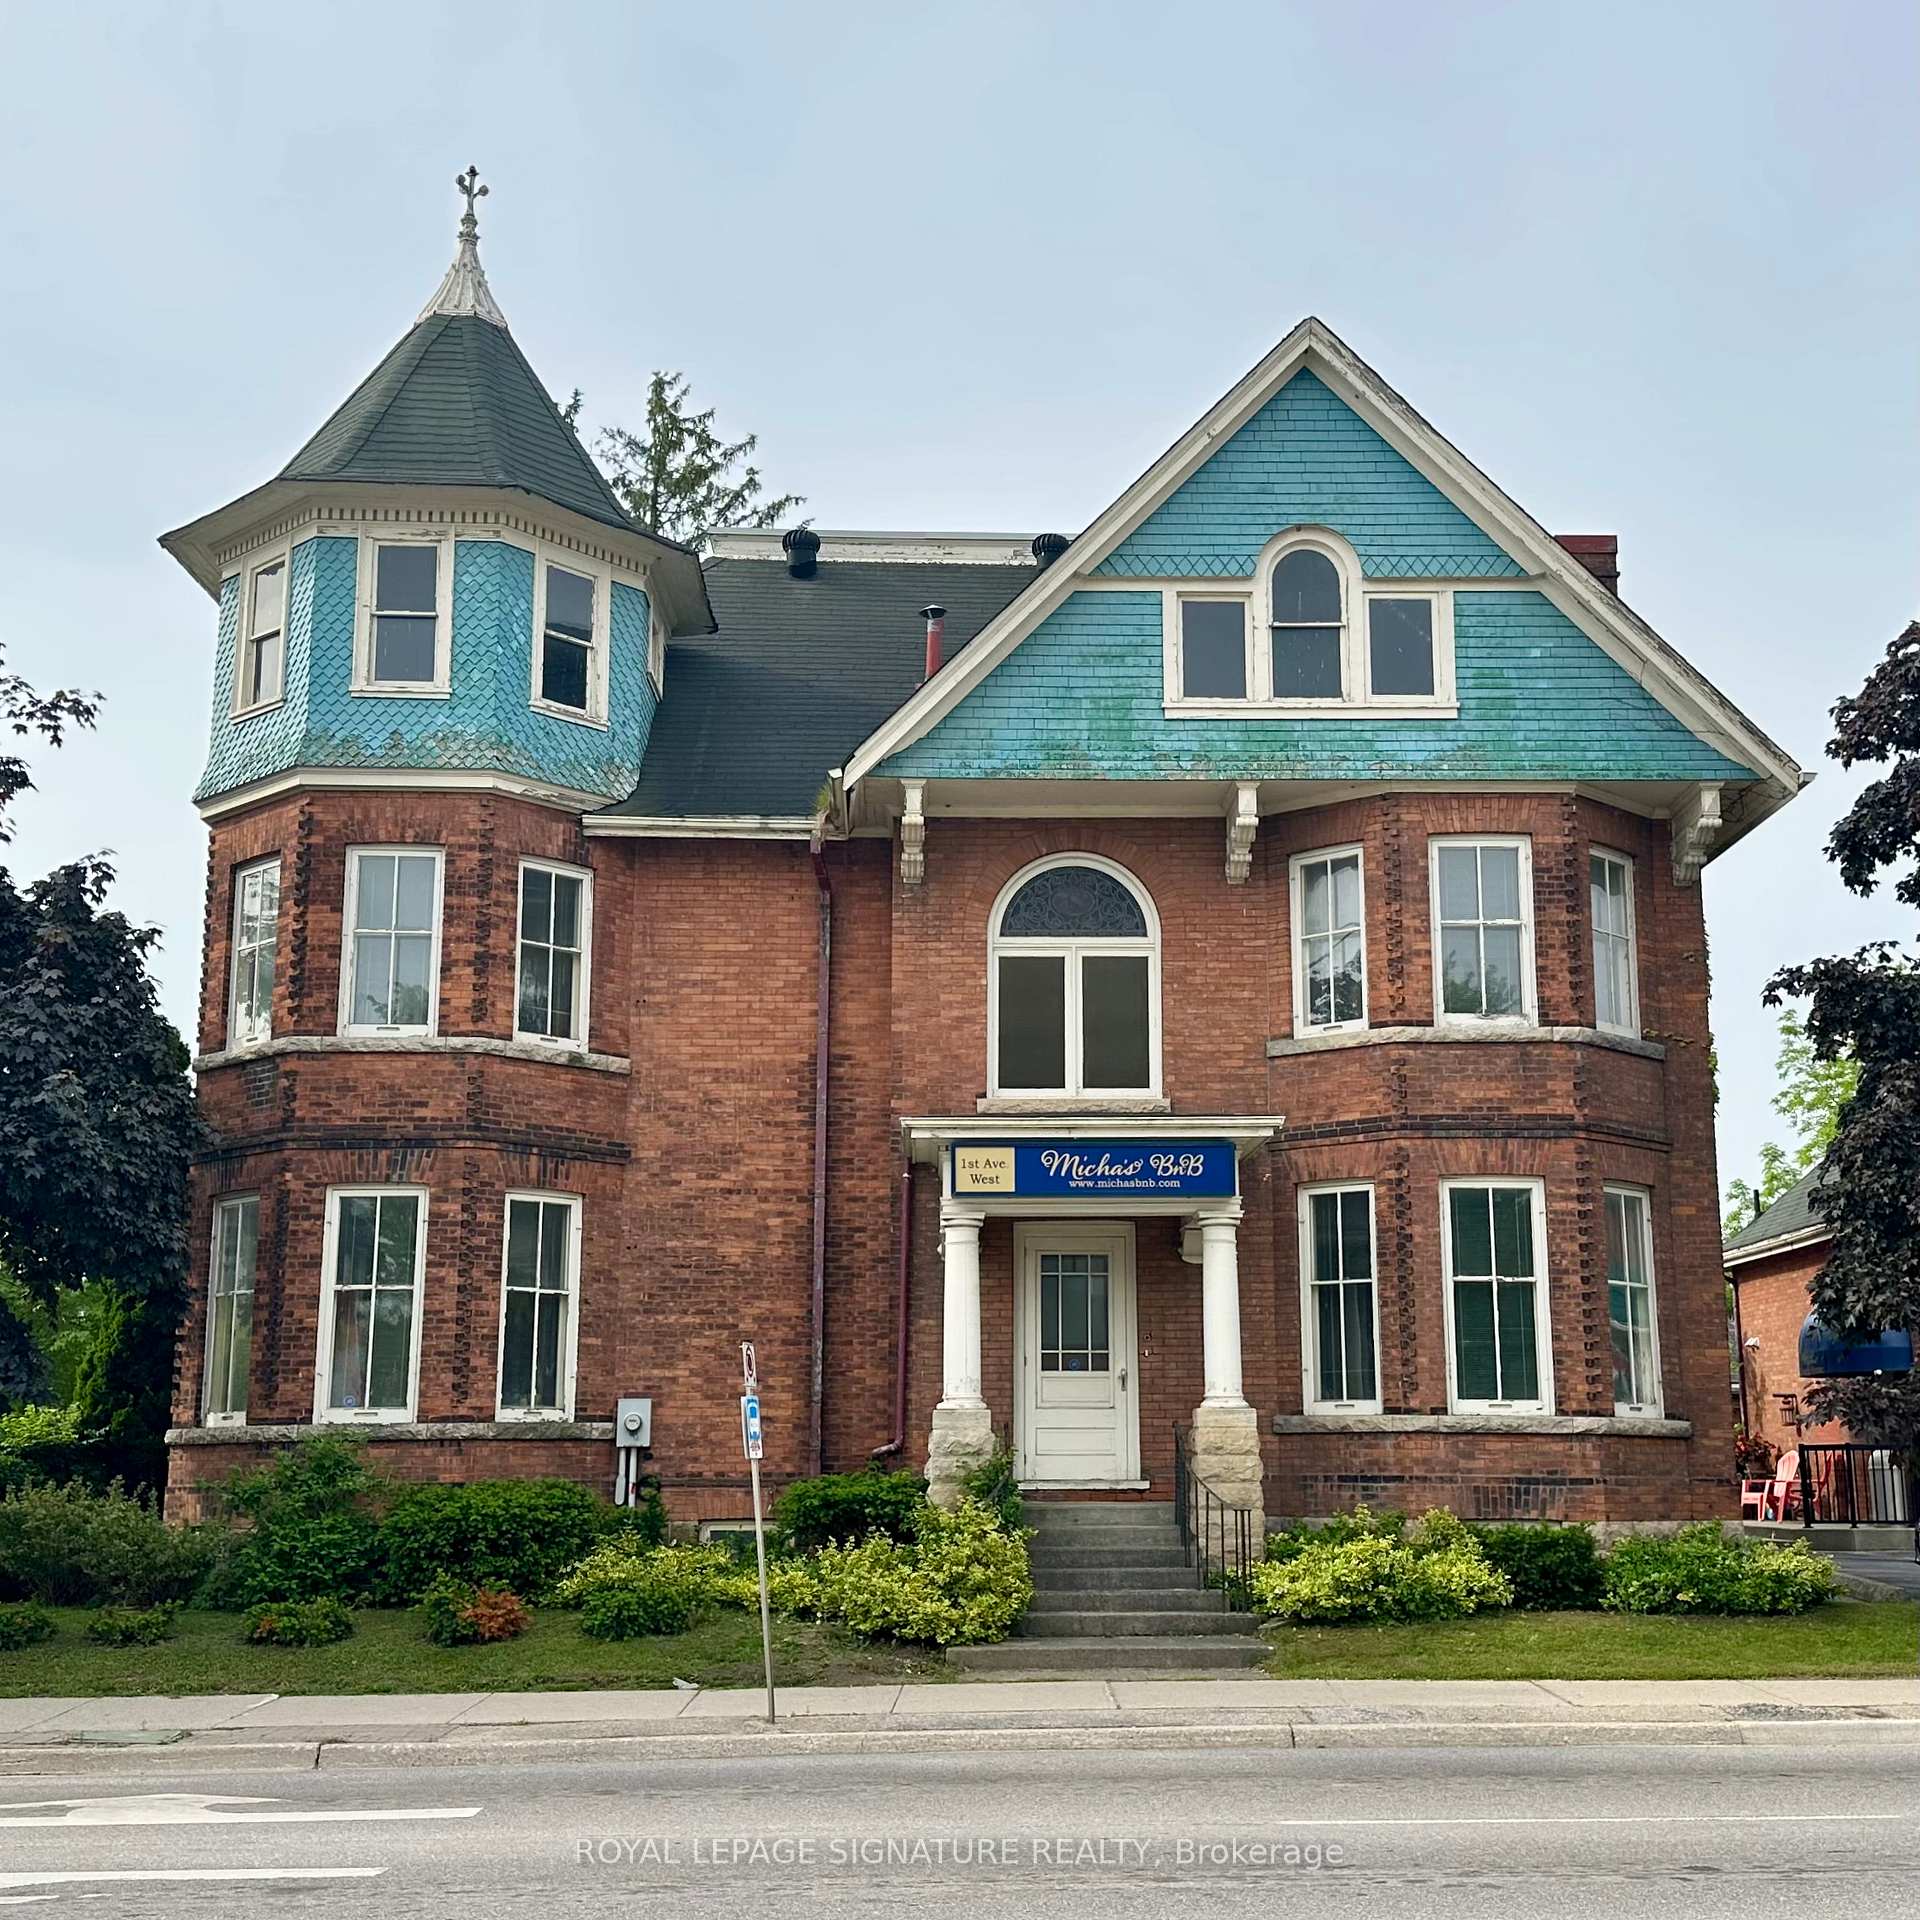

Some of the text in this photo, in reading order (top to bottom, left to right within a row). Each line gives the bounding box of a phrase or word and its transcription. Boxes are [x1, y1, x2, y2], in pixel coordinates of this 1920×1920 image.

[961, 1158, 980, 1169] 1st
[1150, 1153, 1204, 1176] BnB
[970, 1173, 1000, 1185] West
[1068, 1178, 1181, 1188] www.michasbnb.com
